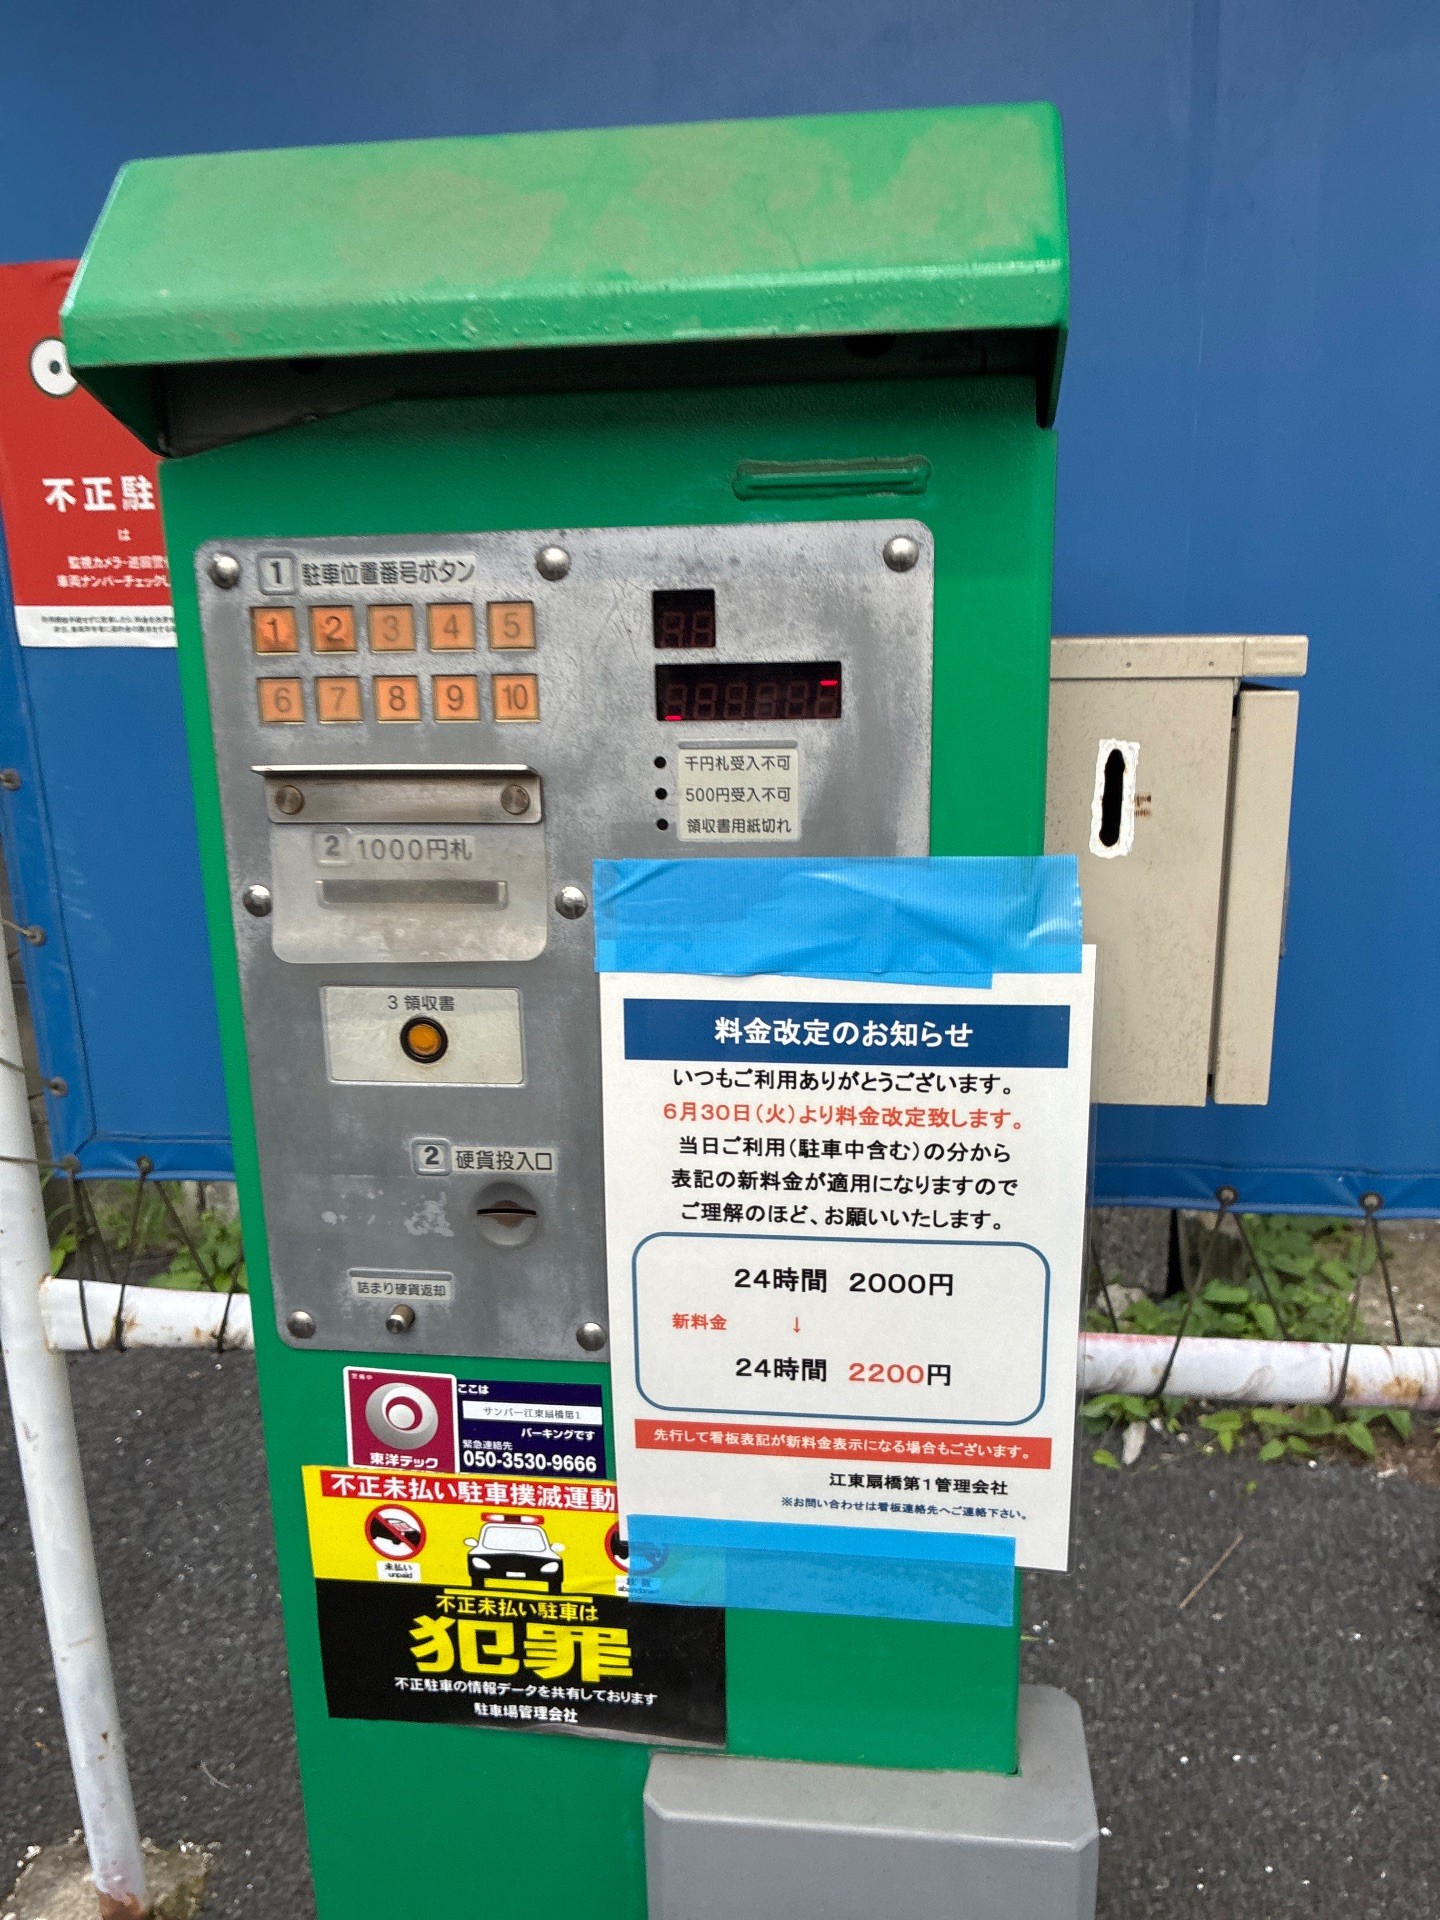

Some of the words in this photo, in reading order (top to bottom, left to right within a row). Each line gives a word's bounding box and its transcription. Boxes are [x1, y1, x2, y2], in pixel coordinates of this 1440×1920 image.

[41, 474, 156, 513] 不正駐
[271, 561, 284, 586] 1
[302, 559, 476, 588] 駐車位置番号ボタン
[268, 619, 279, 643] 1
[324, 616, 343, 642] 2
[382, 615, 400, 641] 3
[442, 613, 460, 639] 4
[502, 612, 520, 639] 5
[273, 688, 290, 712] 6
[330, 687, 347, 711] 7
[389, 686, 406, 711] 8
[447, 685, 463, 710] 9
[502, 684, 529, 709] 10
[685, 755, 790, 772] 千円札受入不可
[685, 786, 791, 803] 500円受入不可
[687, 817, 791, 834] 領収書用紙切れ
[325, 835, 340, 857] 2
[357, 838, 472, 861] 1000円札
[387, 995, 398, 1010] 3
[404, 995, 455, 1012] 領収書
[714, 1016, 974, 1048] 料金改定のお知らせ
[673, 1067, 1012, 1095] いつもご利用ありがとうございます。
[425, 1146, 439, 1165] 2
[456, 1149, 553, 1171] 硬貨投入口
[671, 1167, 1018, 1196] 表記の新料金が適用になりますので
[681, 1202, 1002, 1231] ご理解のほど、お願いいたします。
[357, 1281, 446, 1297] 詰まり硬貨返却
[734, 1268, 828, 1294] 24時間
[849, 1272, 954, 1297] 2000円
[671, 1312, 728, 1332] 新料金
[735, 1357, 828, 1383] 24時間
[848, 1361, 952, 1387] 2200円
[458, 1384, 489, 1395] ここは
[462, 1439, 513, 1451] 緊急連絡先
[653, 1427, 1030, 1461] 先行して看板表記が新料金表示になる場合もございます。
[370, 1452, 438, 1469] 東洋テック
[463, 1450, 598, 1473] 050-3530-9666
[331, 1473, 616, 1512] 不正未払い駐車撲滅運動
[829, 1472, 1009, 1496] 江東扇橋第1管理会社
[436, 1595, 600, 1622] 不正未払い駐車は
[409, 1614, 633, 1683] 犯罪
[394, 1676, 658, 1706] 不正駐車の情報データを共有しております
[474, 1702, 579, 1724] 駐車場管理会社
